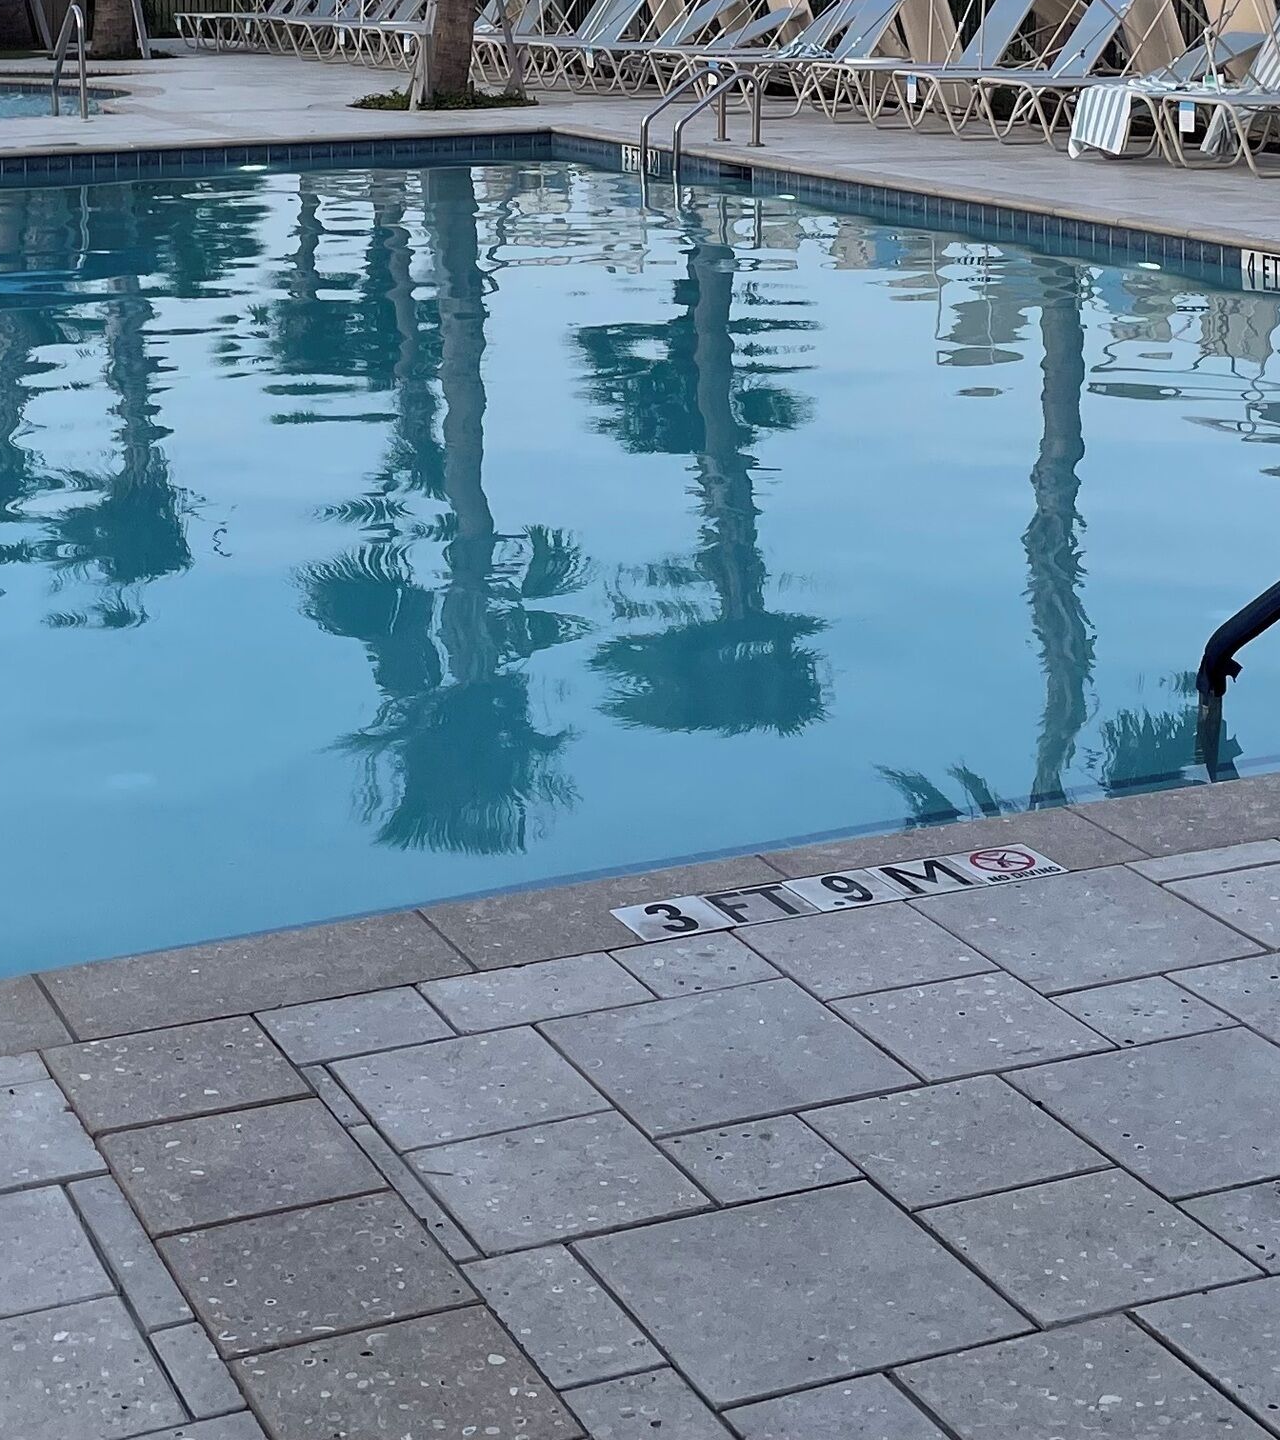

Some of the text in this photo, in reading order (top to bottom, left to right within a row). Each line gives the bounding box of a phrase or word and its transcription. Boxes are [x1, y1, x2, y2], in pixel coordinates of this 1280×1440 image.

[644, 903, 699, 932] 3
[704, 885, 800, 923] FT
[878, 859, 974, 894] M
[987, 866, 1061, 883] NO DIVING
